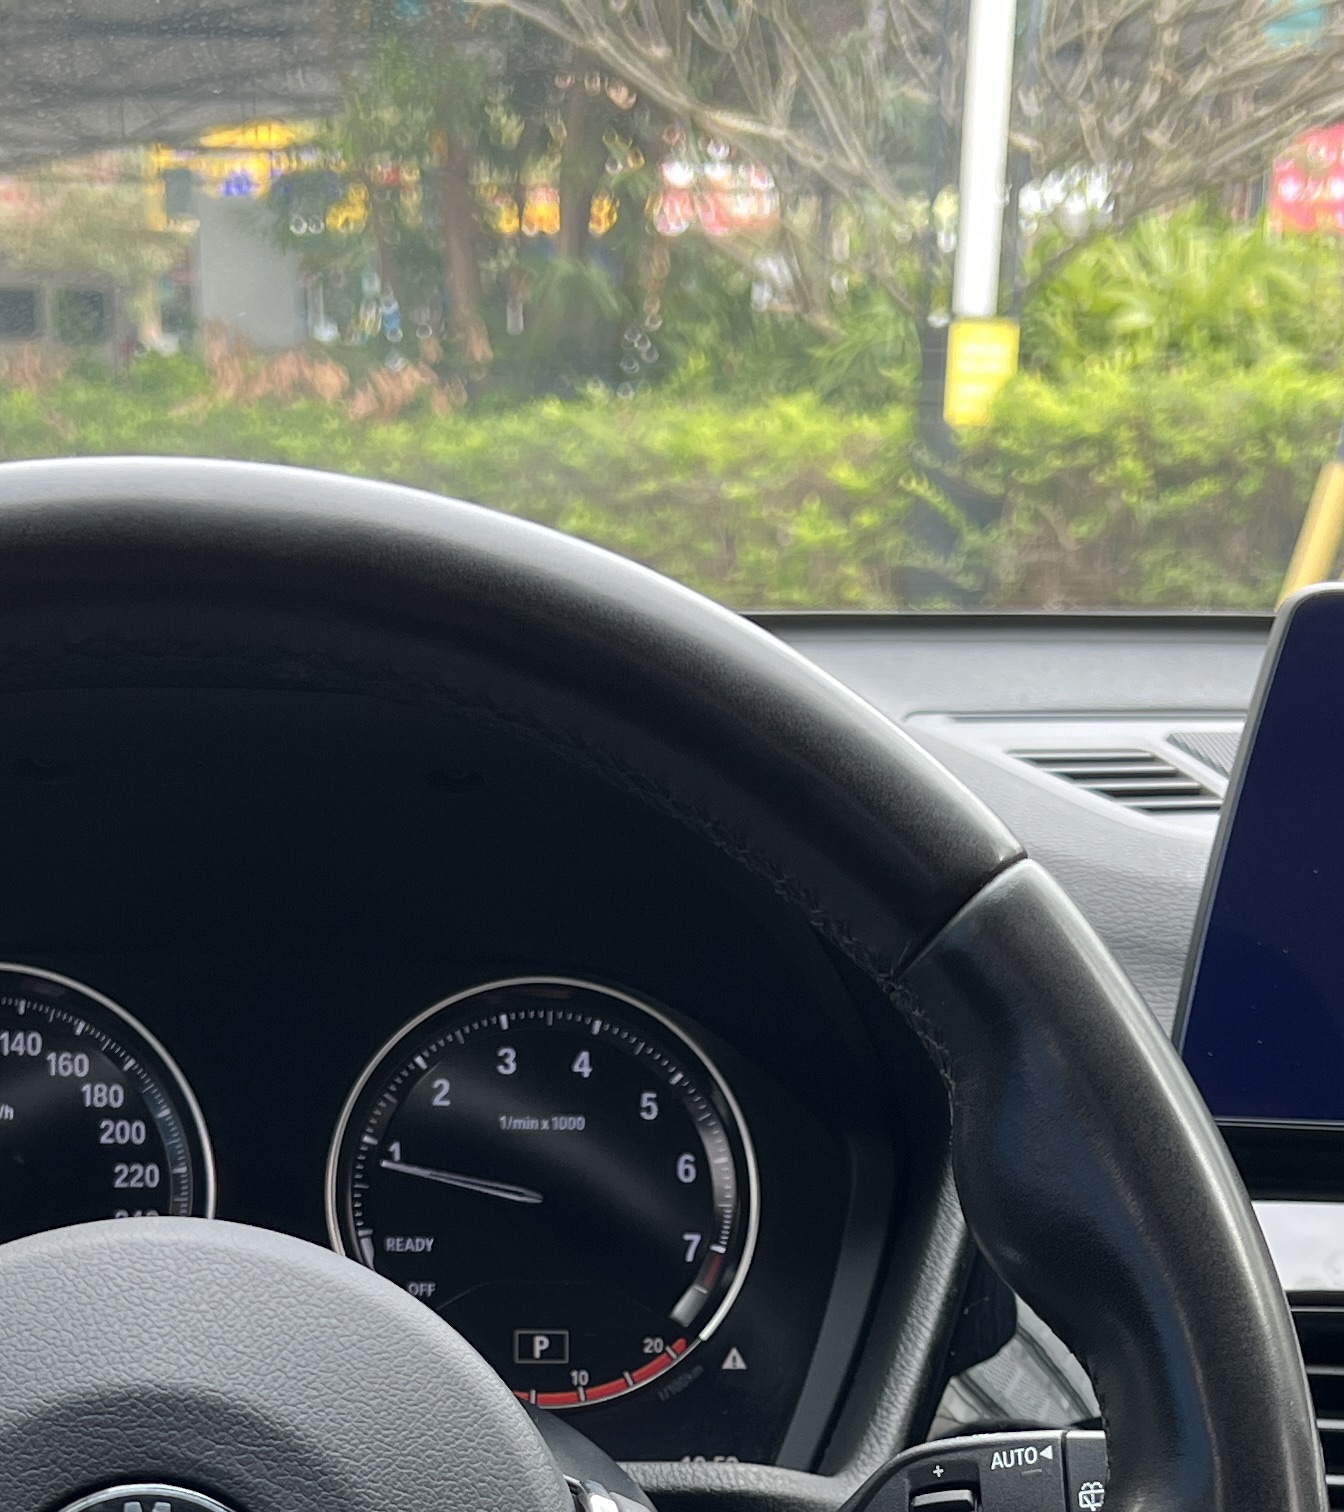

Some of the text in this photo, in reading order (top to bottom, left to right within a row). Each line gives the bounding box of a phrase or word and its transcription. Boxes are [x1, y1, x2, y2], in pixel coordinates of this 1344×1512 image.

[46, 1051, 90, 1078] 160
[496, 1047, 517, 1075] 3
[572, 1050, 593, 1078] 4
[81, 1082, 125, 1109] 180
[432, 1078, 452, 1107] 2
[639, 1092, 659, 1121] 5
[99, 1119, 146, 1145] 200
[388, 1141, 402, 1162] 1
[113, 1163, 160, 1189] 220
[676, 1153, 697, 1183] 6
[385, 1237, 435, 1254] READY
[682, 1233, 702, 1263] 7
[407, 1282, 436, 1297] OFF
[532, 1335, 551, 1360] P
[642, 1337, 665, 1354] 20
[570, 1369, 590, 1386] 10
[990, 1446, 1038, 1471] AUTO
